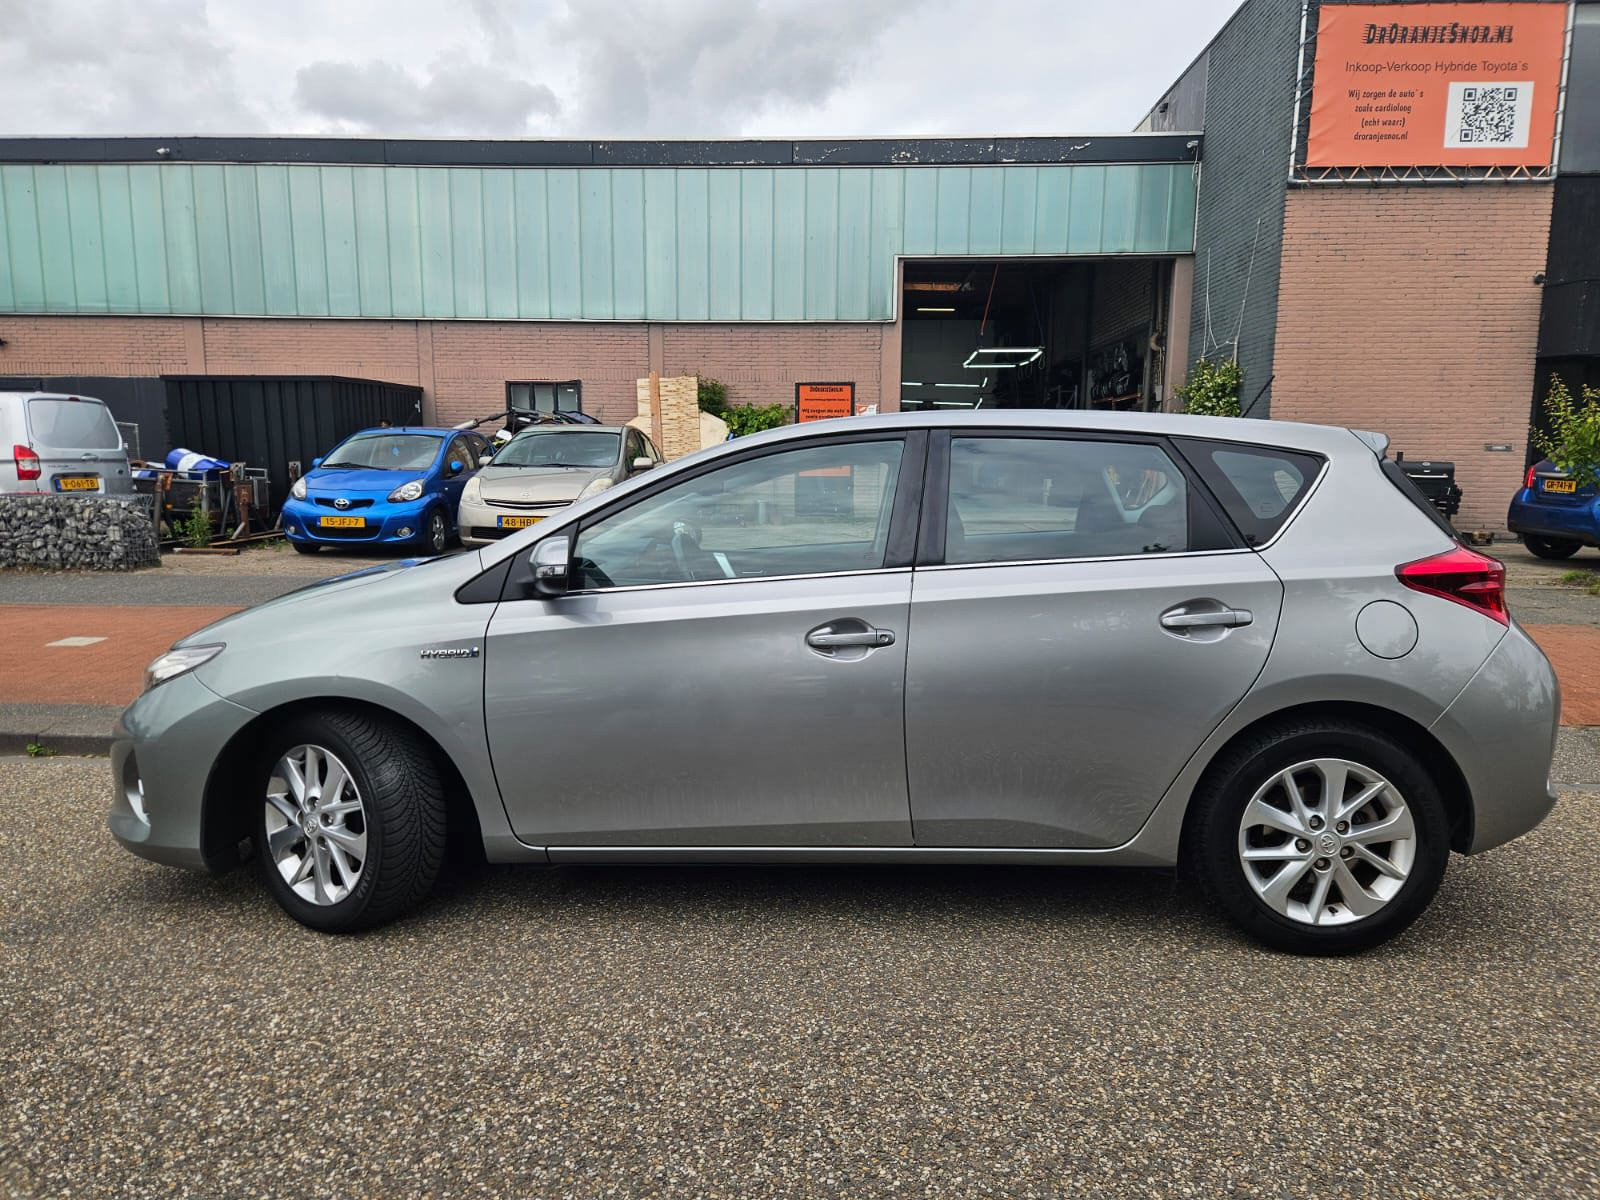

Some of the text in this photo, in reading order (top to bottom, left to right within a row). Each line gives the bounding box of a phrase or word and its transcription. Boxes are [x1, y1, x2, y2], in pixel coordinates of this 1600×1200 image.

[1345, 61, 1431, 73] Inkoop-Verkoop
[1435, 61, 1478, 73] Hybride
[1348, 89, 1360, 100] Wij
[1362, 91, 1386, 100] zorgen
[1388, 89, 1397, 98] de
[1355, 103, 1412, 114] zoals cardioloog
[1361, 117, 1380, 128] (echt
[1354, 131, 1409, 142] droranjesnor.nl
[420, 649, 470, 659] HYBRID
